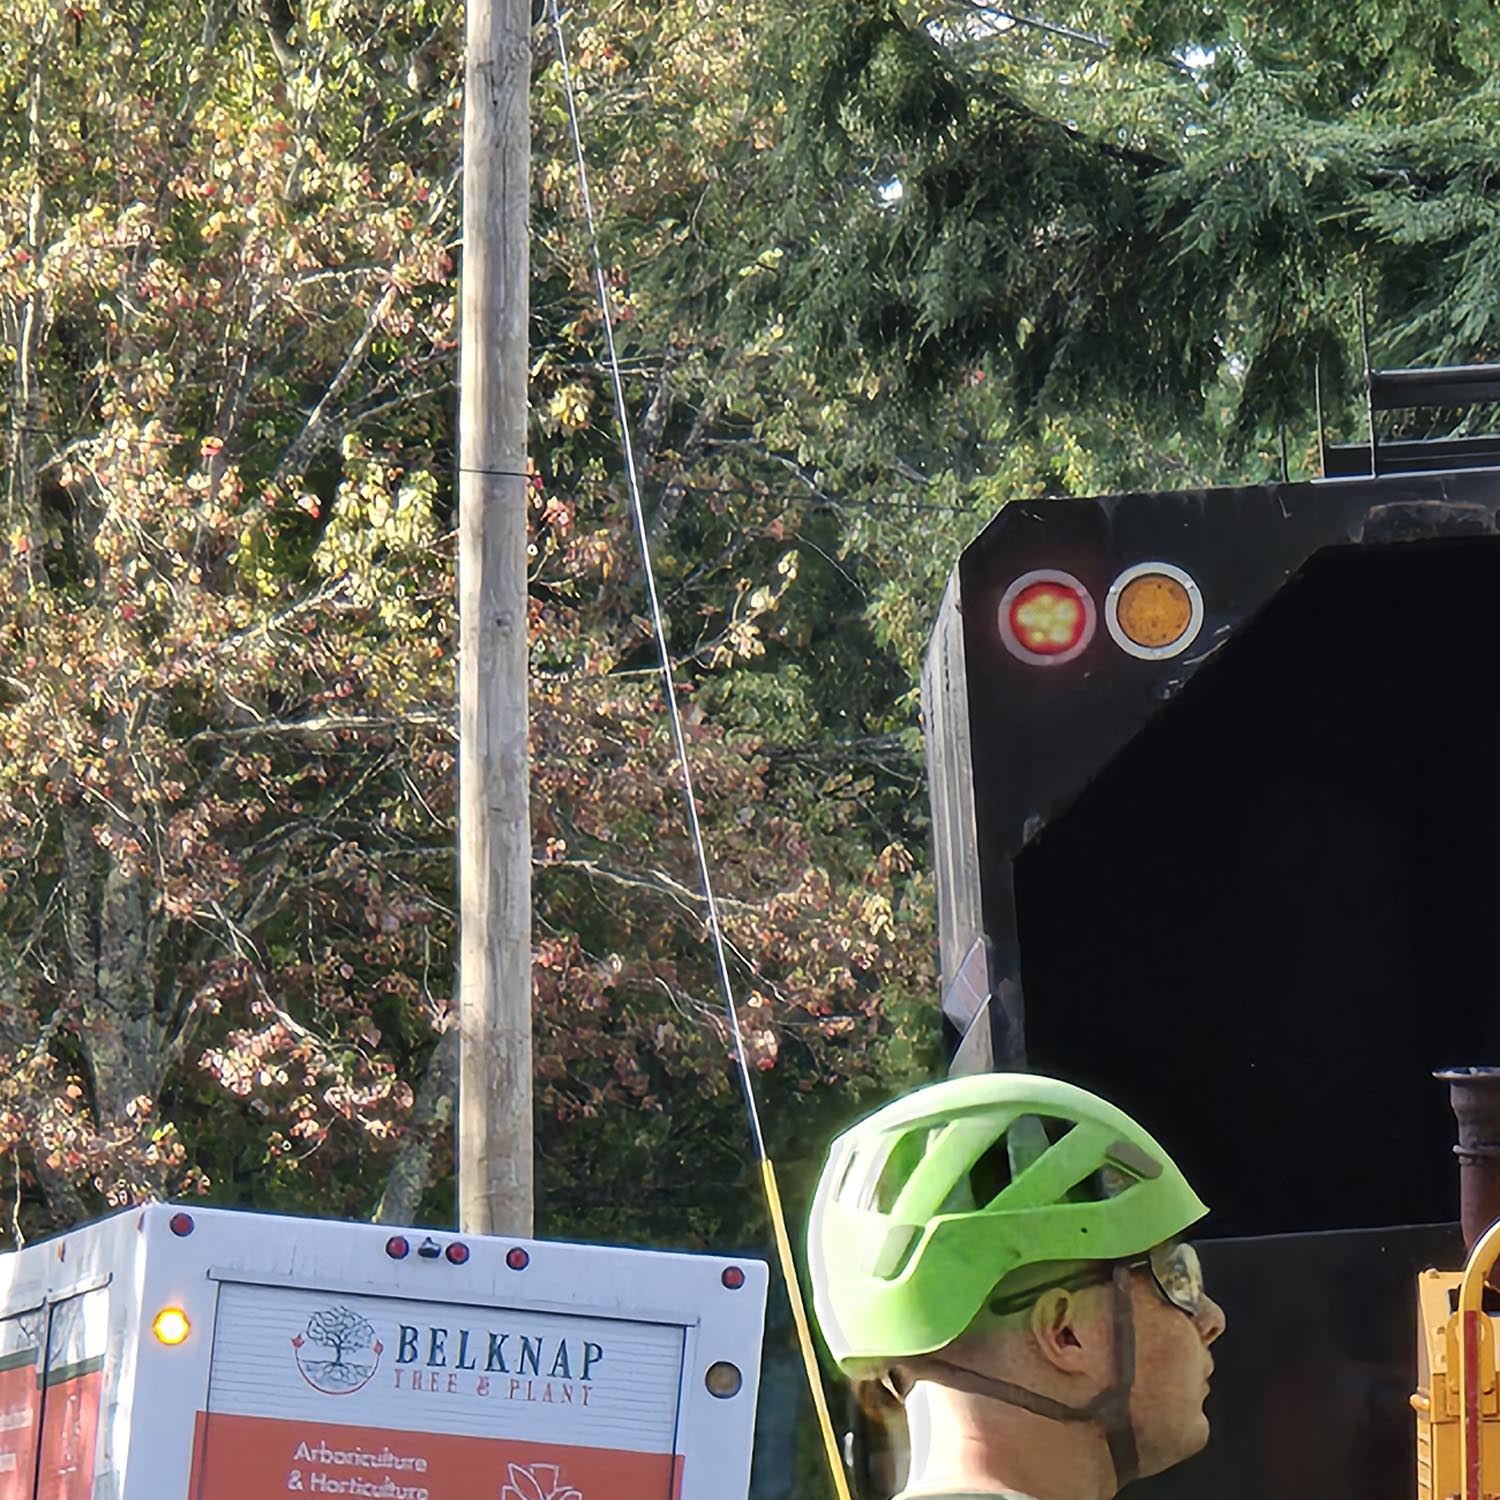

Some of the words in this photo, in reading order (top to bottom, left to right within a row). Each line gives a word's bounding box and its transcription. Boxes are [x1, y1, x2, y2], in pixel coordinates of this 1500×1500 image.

[395, 1323, 604, 1381] BELKNAP
[393, 1369, 458, 1394] TREE
[475, 1375, 490, 1397] &
[507, 1379, 593, 1407] PLANT
[293, 1440, 428, 1473] Arboriculture
[287, 1469, 304, 1491] &
